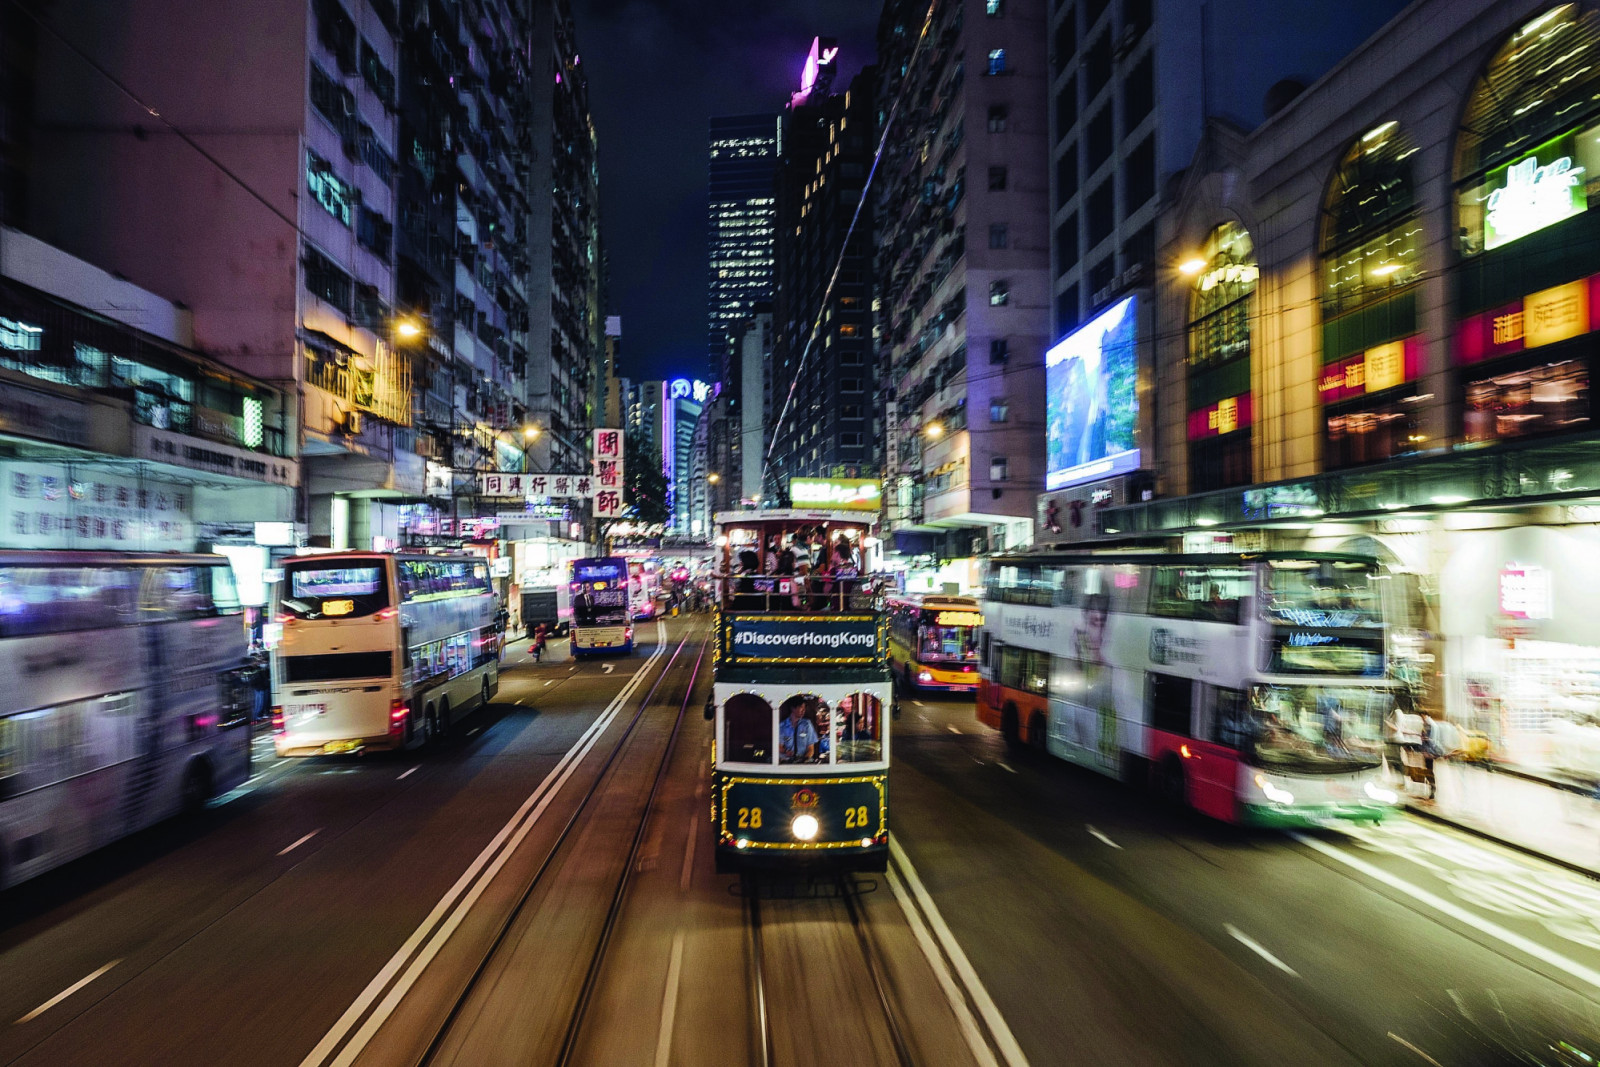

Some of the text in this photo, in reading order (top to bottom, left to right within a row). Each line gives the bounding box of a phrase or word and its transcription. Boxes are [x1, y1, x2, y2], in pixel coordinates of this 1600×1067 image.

[734, 631, 875, 648] #DiscoverHongKong
[738, 807, 762, 829] 28
[845, 806, 868, 829] 28
